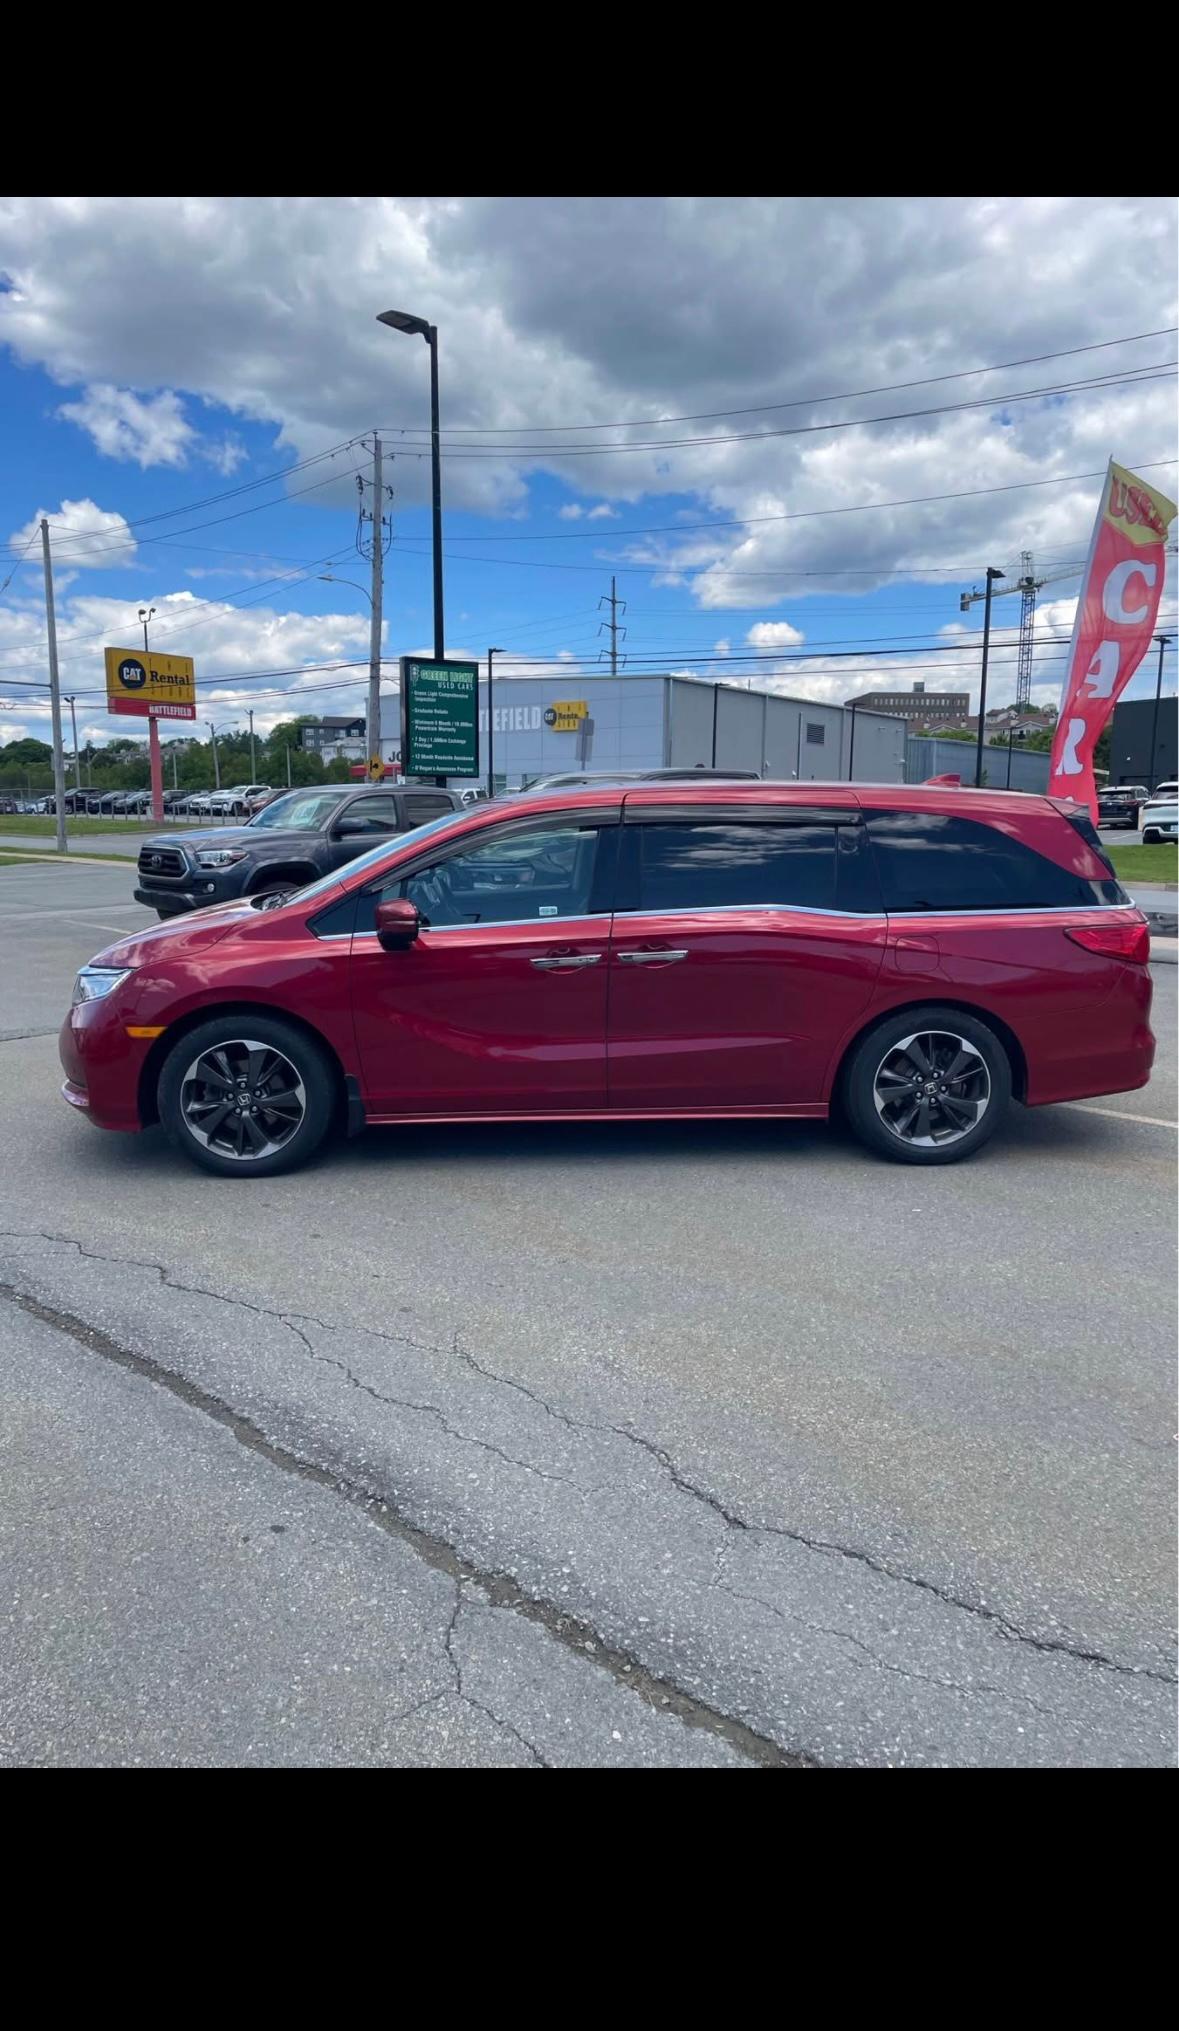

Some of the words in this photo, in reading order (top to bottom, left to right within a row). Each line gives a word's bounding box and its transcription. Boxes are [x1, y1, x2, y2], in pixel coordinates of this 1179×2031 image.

[122, 666, 141, 681] CAT
[149, 670, 190, 685] Rental
[420, 670, 448, 681] GREEN
[449, 672, 473, 683] LIGHT
[437, 681, 454, 689] USED
[457, 682, 473, 690] CARS
[149, 704, 192, 716] BATTLEFIELD
